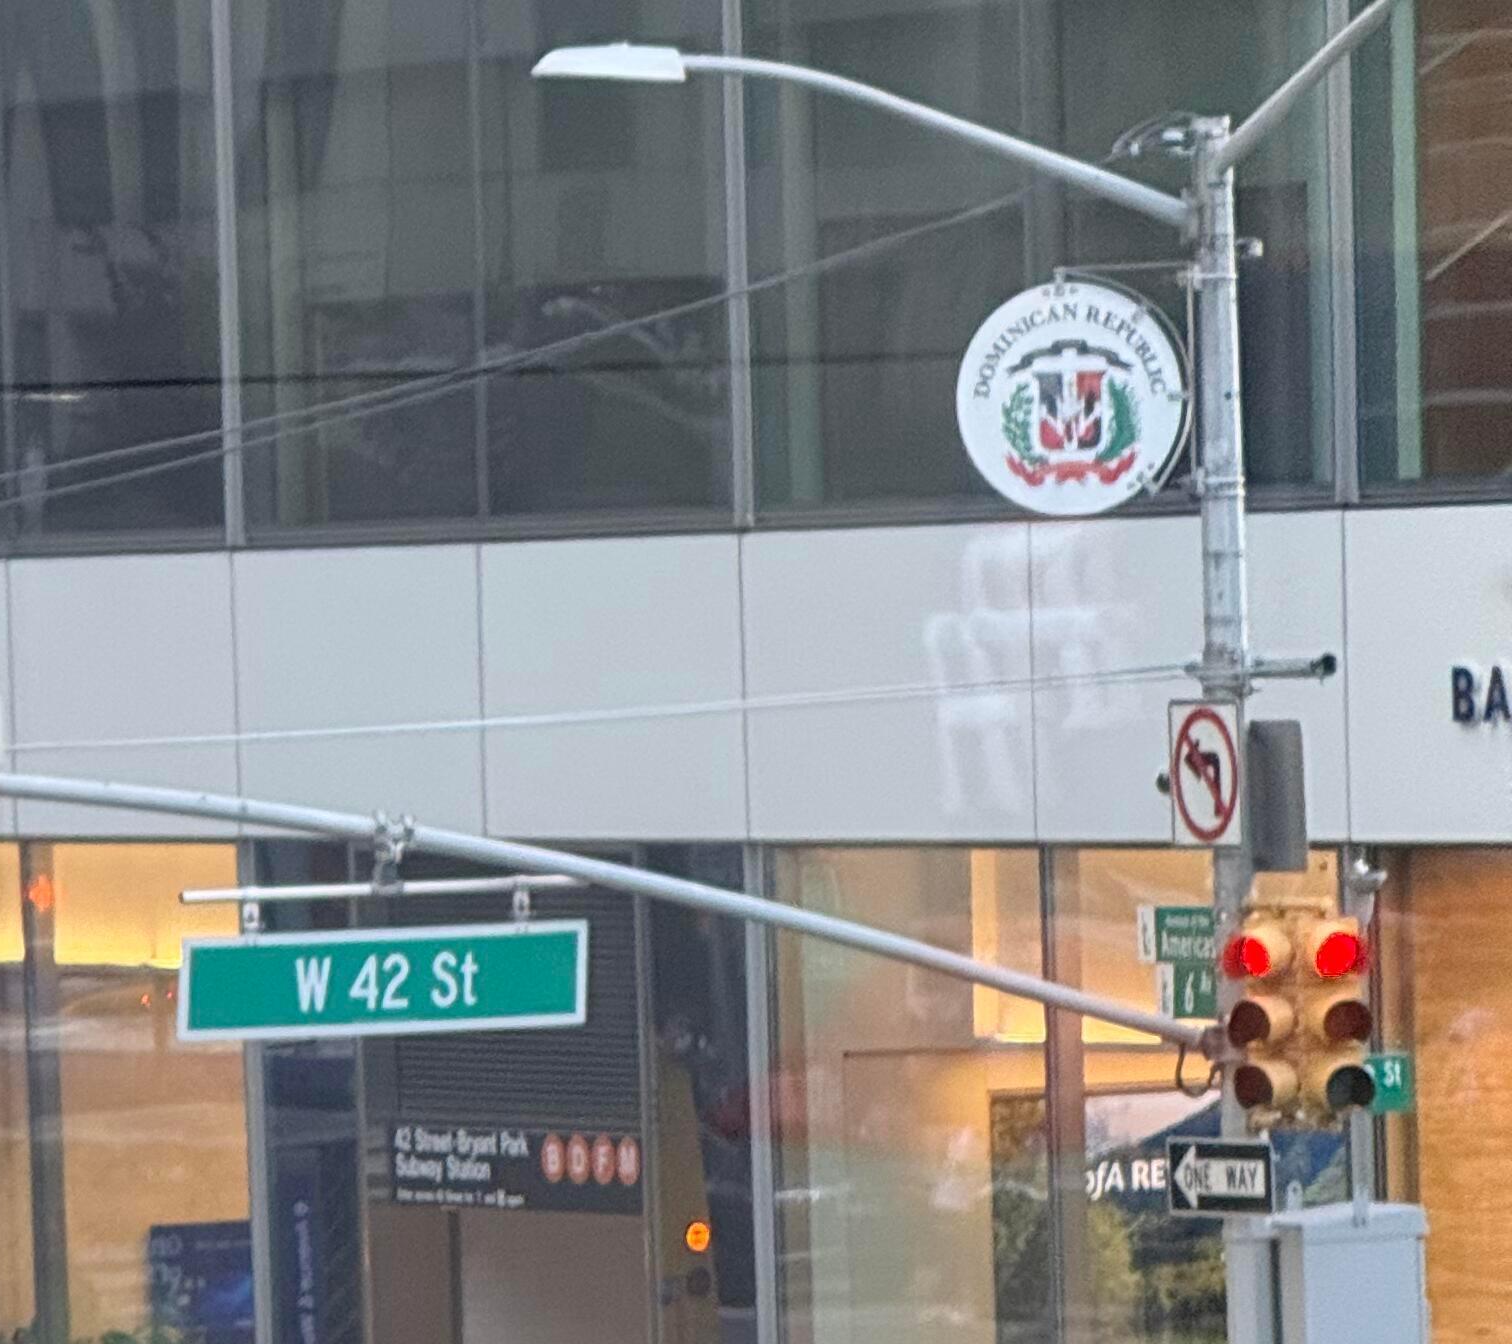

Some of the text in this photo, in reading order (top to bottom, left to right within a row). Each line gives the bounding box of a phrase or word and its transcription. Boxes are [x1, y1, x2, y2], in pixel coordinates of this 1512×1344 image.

[972, 303, 1168, 399] DOMINICAN REPUBLIC
[295, 950, 480, 1014] W 42 St
[395, 1152, 492, 1183] Subway Station
[1183, 1161, 1258, 1193] ONE WAY
